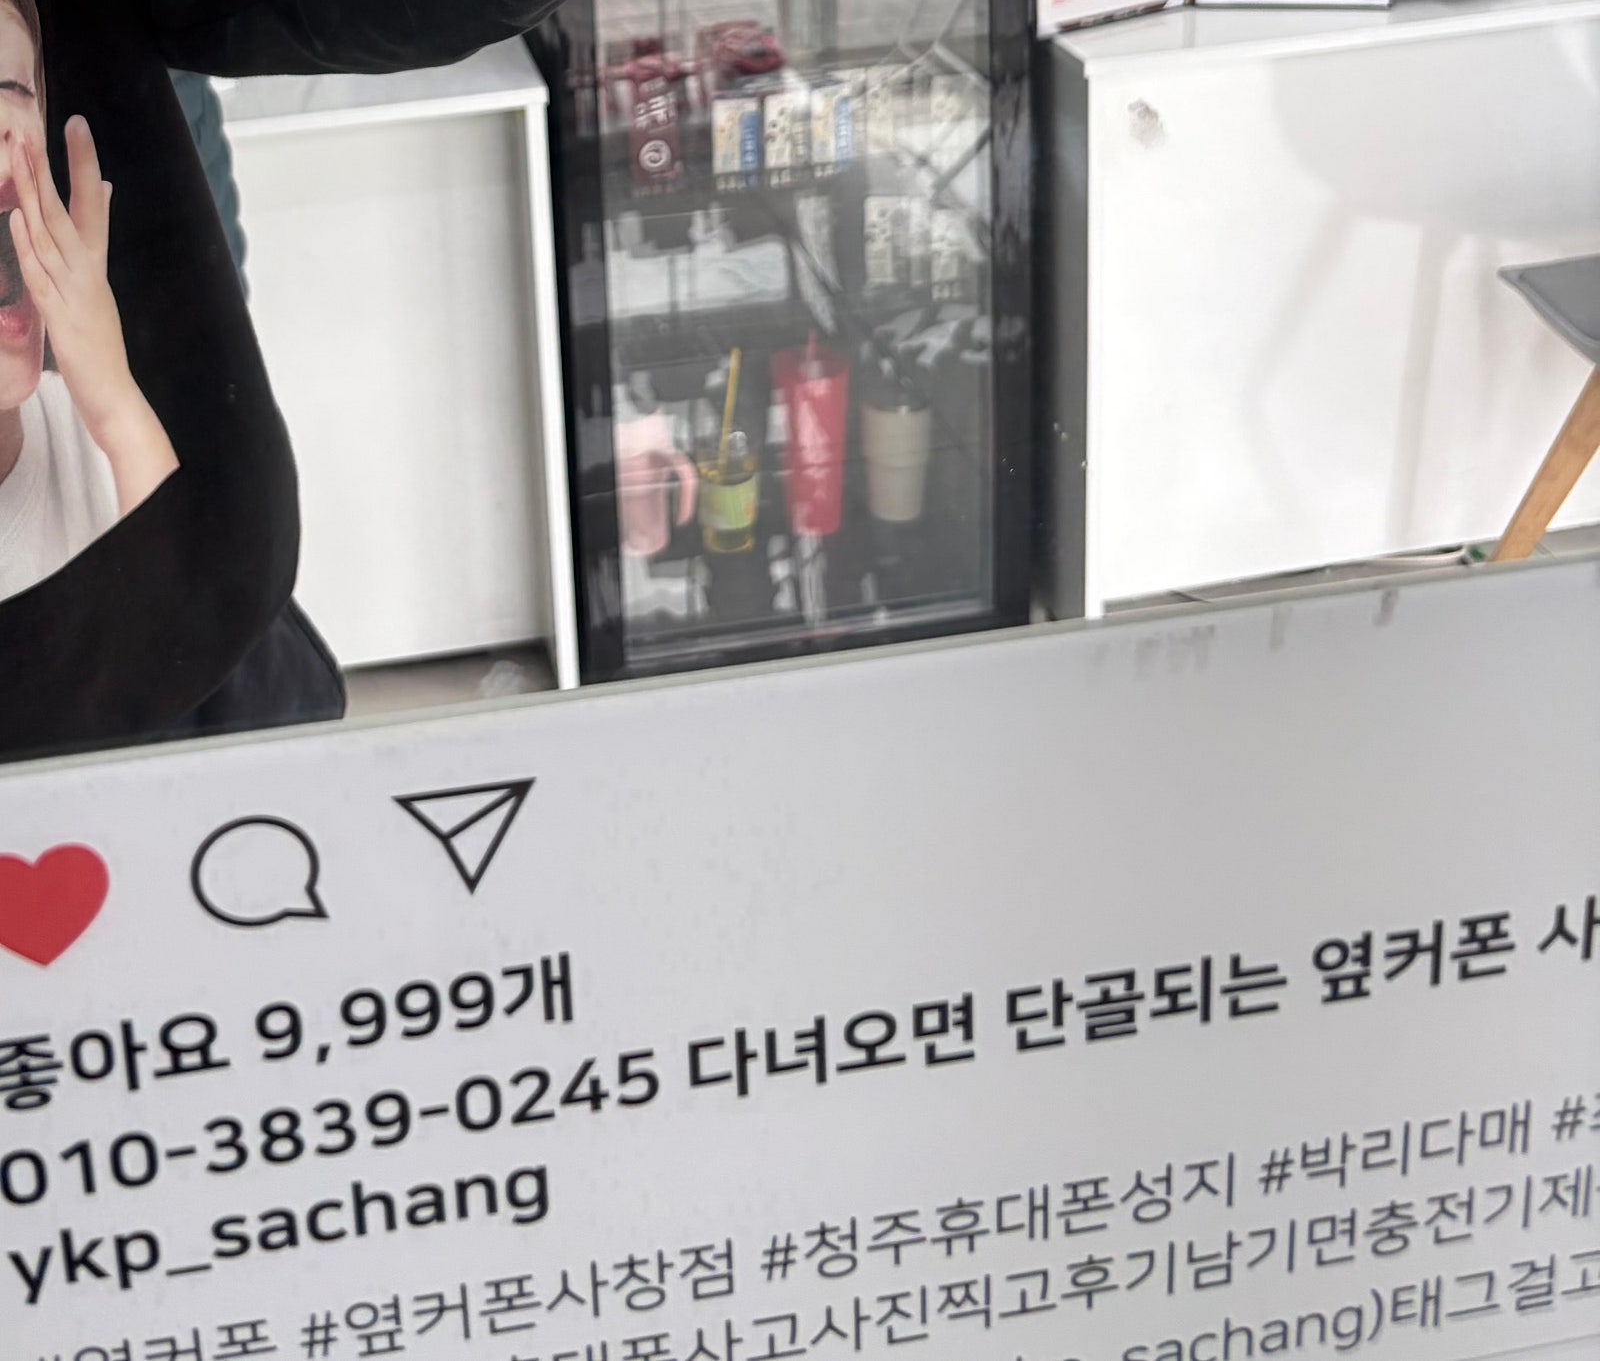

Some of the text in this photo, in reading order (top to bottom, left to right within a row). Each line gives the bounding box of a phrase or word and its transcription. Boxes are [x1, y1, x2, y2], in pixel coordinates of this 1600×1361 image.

[0, 950, 575, 1111] 좋아요 9,999개
[0, 1048, 661, 1206] 010-3839-0245
[687, 991, 977, 1097] 다녀오면
[1006, 953, 1288, 1052] 단골되는
[1311, 911, 1516, 1005] 옆커폰
[9, 1164, 552, 1305] ykp_sachang
[38, 1319, 278, 1361] 커폰
[300, 1236, 736, 1358] #옆커폰사창점
[760, 1152, 1237, 1282] #청주휴대폰성지
[1258, 1099, 1533, 1196] #박리다매
